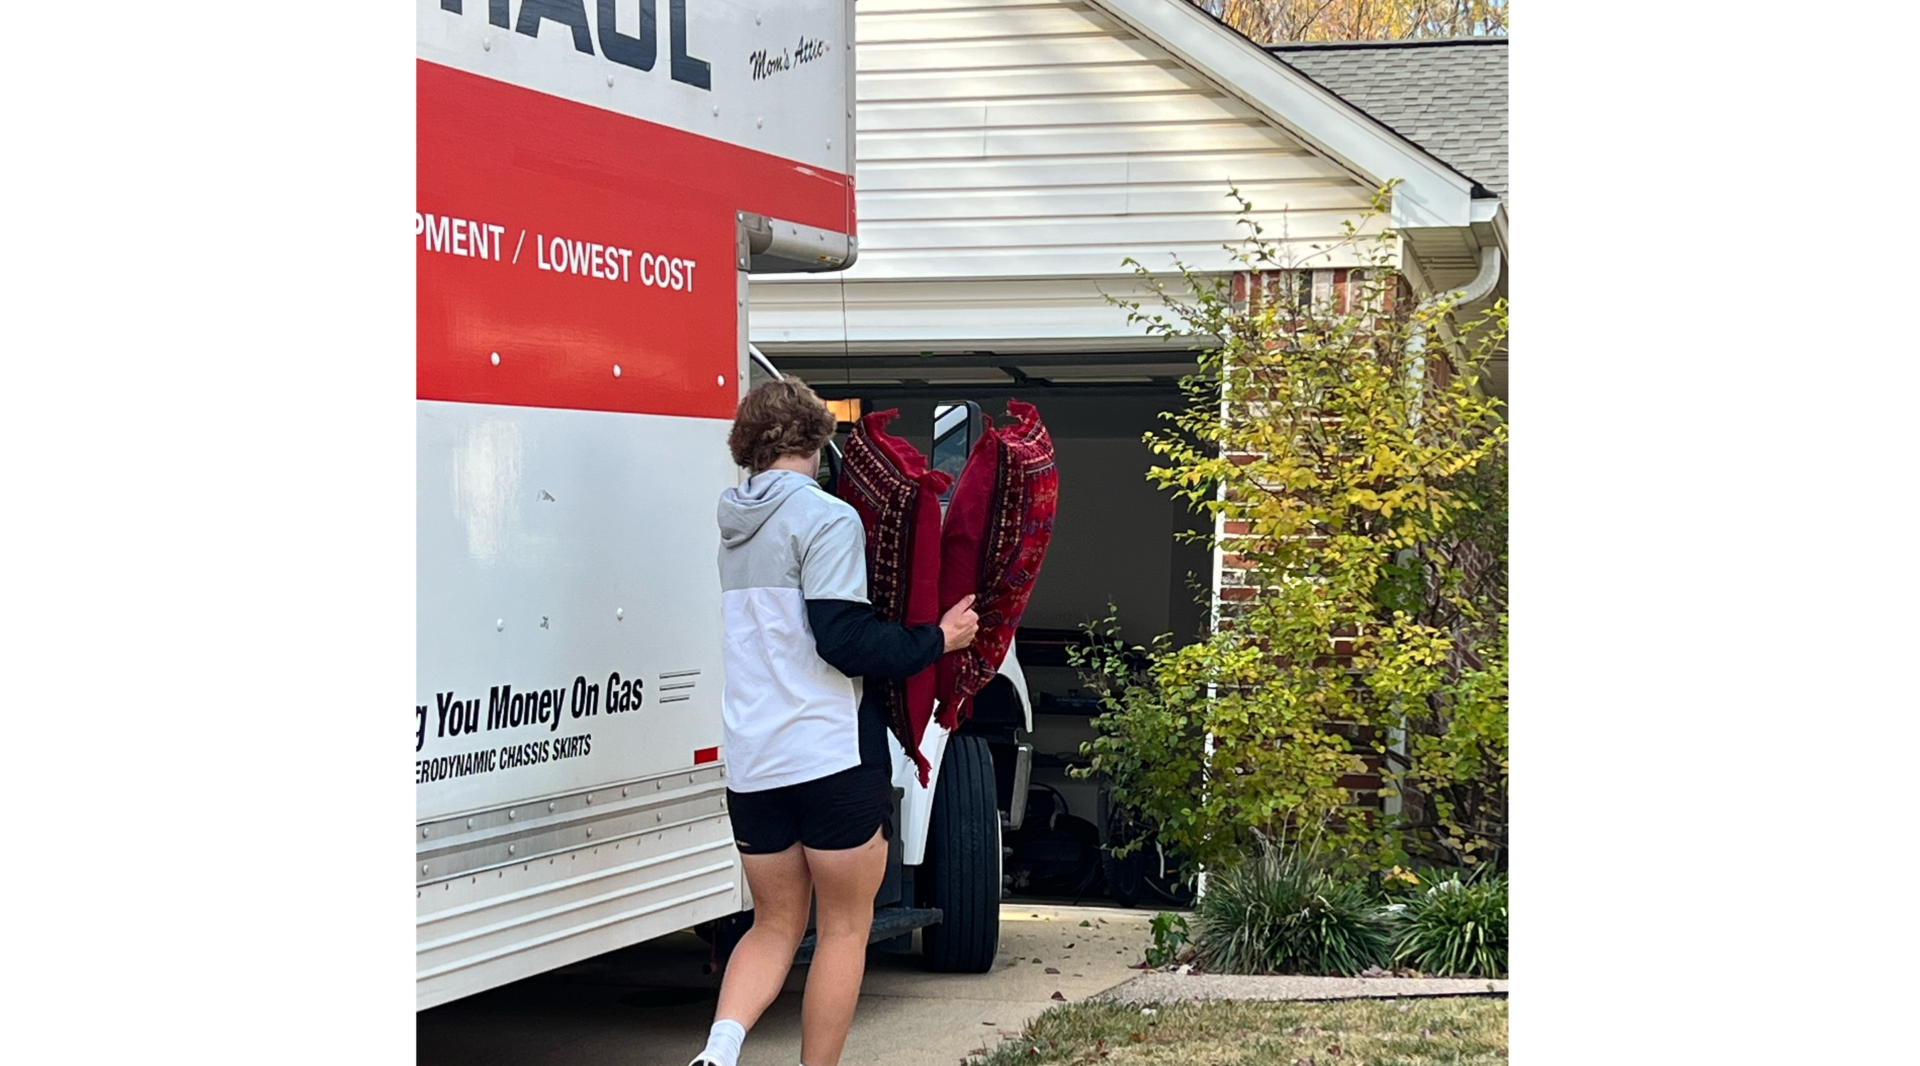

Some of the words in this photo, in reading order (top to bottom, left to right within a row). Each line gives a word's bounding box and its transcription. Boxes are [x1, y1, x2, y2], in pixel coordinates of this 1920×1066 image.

[439, 0, 711, 91] AUL
[749, 48, 790, 81] Mom's
[793, 34, 824, 69] Attic
[512, 229, 526, 265] /
[537, 234, 633, 283] LOWEST
[640, 252, 696, 293] COST
[436, 691, 480, 738] You
[486, 684, 566, 732] Money
[571, 676, 599, 719] On
[605, 672, 643, 714] Gas
[499, 740, 549, 770] CHASSIS
[552, 733, 592, 761] SKIRTS
